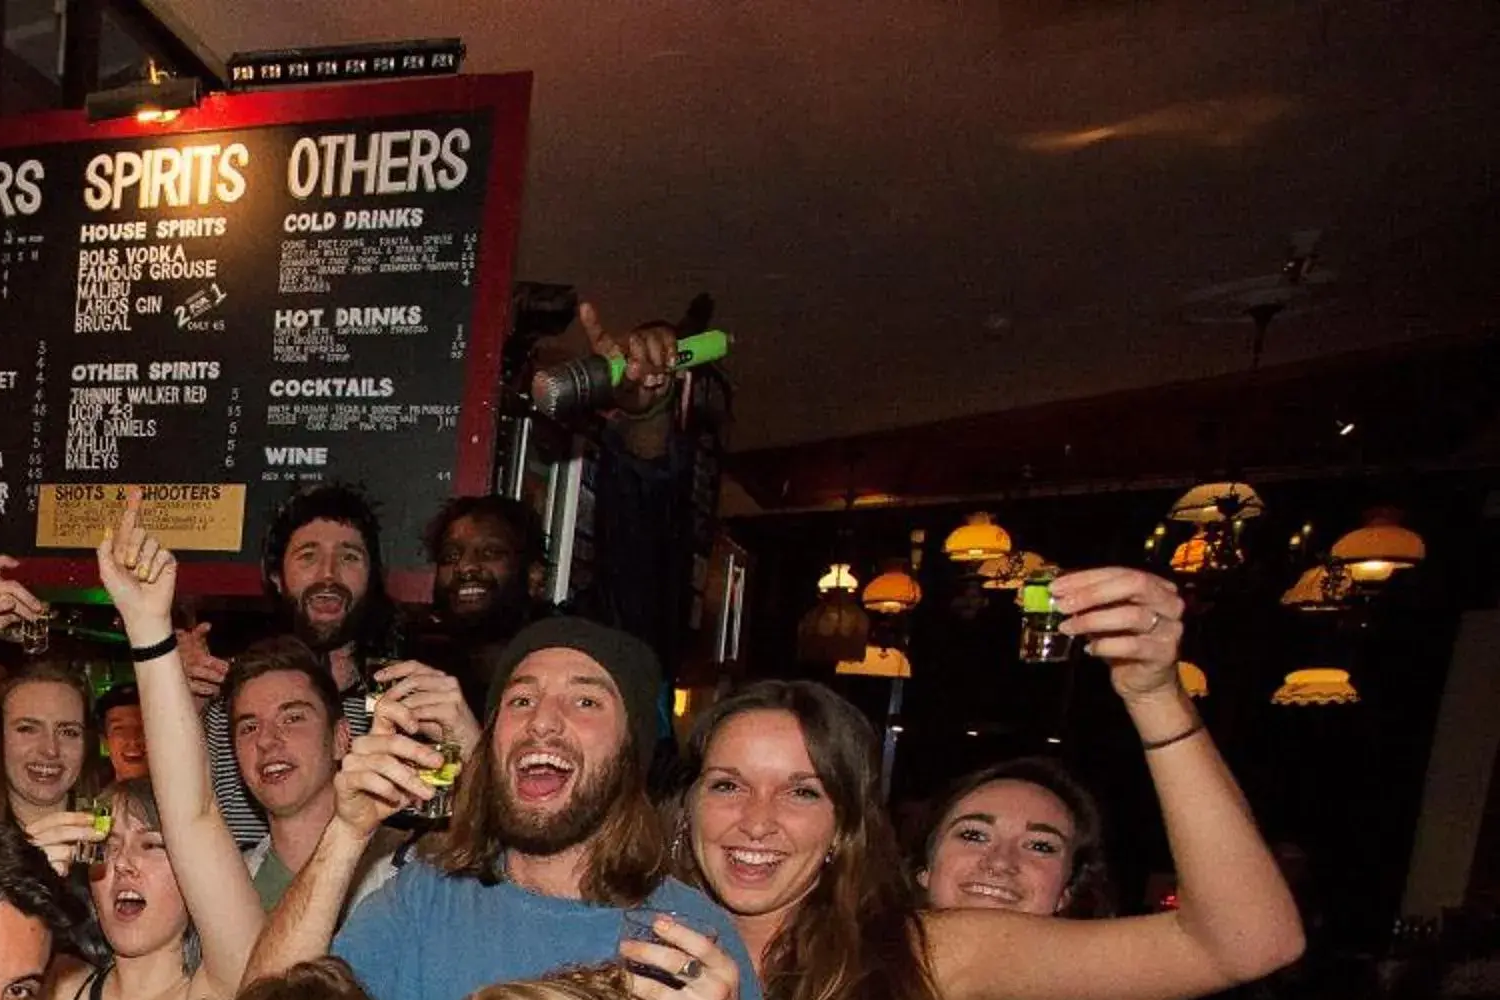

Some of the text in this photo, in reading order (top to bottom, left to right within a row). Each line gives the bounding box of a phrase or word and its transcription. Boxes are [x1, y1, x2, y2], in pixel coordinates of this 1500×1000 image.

[288, 128, 471, 200] OTHERS
[84, 142, 249, 211] SPIRITS
[284, 207, 424, 232] COLD DRINKS
[80, 217, 227, 243] HOUSE SPIRITS
[78, 244, 186, 267] BOLS VODKA
[78, 259, 217, 283] FAMOUS GROUSE
[77, 281, 131, 299] MALIBU
[75, 295, 163, 317] LARIOS GIN
[74, 314, 132, 334] BRUGAL
[173, 305, 191, 329] 2
[275, 306, 422, 329] HOT DRINKS
[71, 361, 221, 382] OTHER SPIRITS
[127, 386, 180, 405] WALKER
[184, 386, 207, 404] RED
[269, 378, 395, 397] COCKTAILS
[68, 404, 104, 421] LICOR
[68, 419, 157, 438] JACK DANIELS
[66, 437, 118, 454] KAHLUA
[65, 453, 120, 470] BAILEYS
[264, 447, 329, 465] WINE
[55, 486, 105, 501] SHOTS
